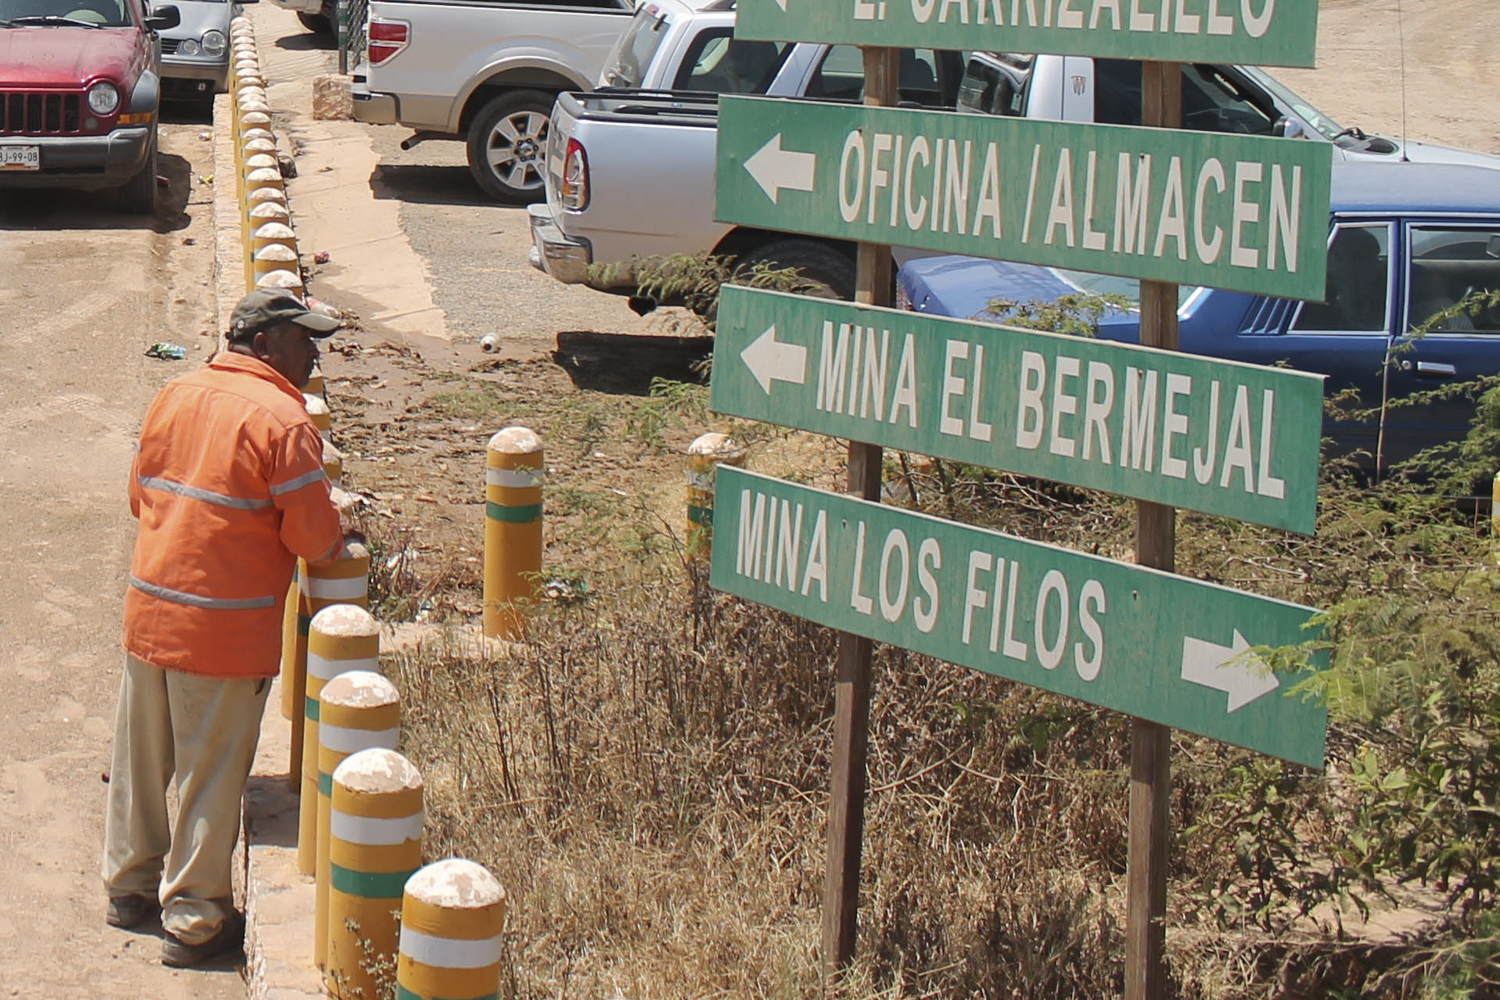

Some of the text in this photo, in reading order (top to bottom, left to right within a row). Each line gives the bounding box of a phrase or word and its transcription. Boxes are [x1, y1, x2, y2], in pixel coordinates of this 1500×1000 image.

[839, 130, 1002, 239] OFICINA
[815, 321, 1286, 500] MINA EL BERMEJAL
[736, 489, 1107, 681] MINA LOS FILOS
